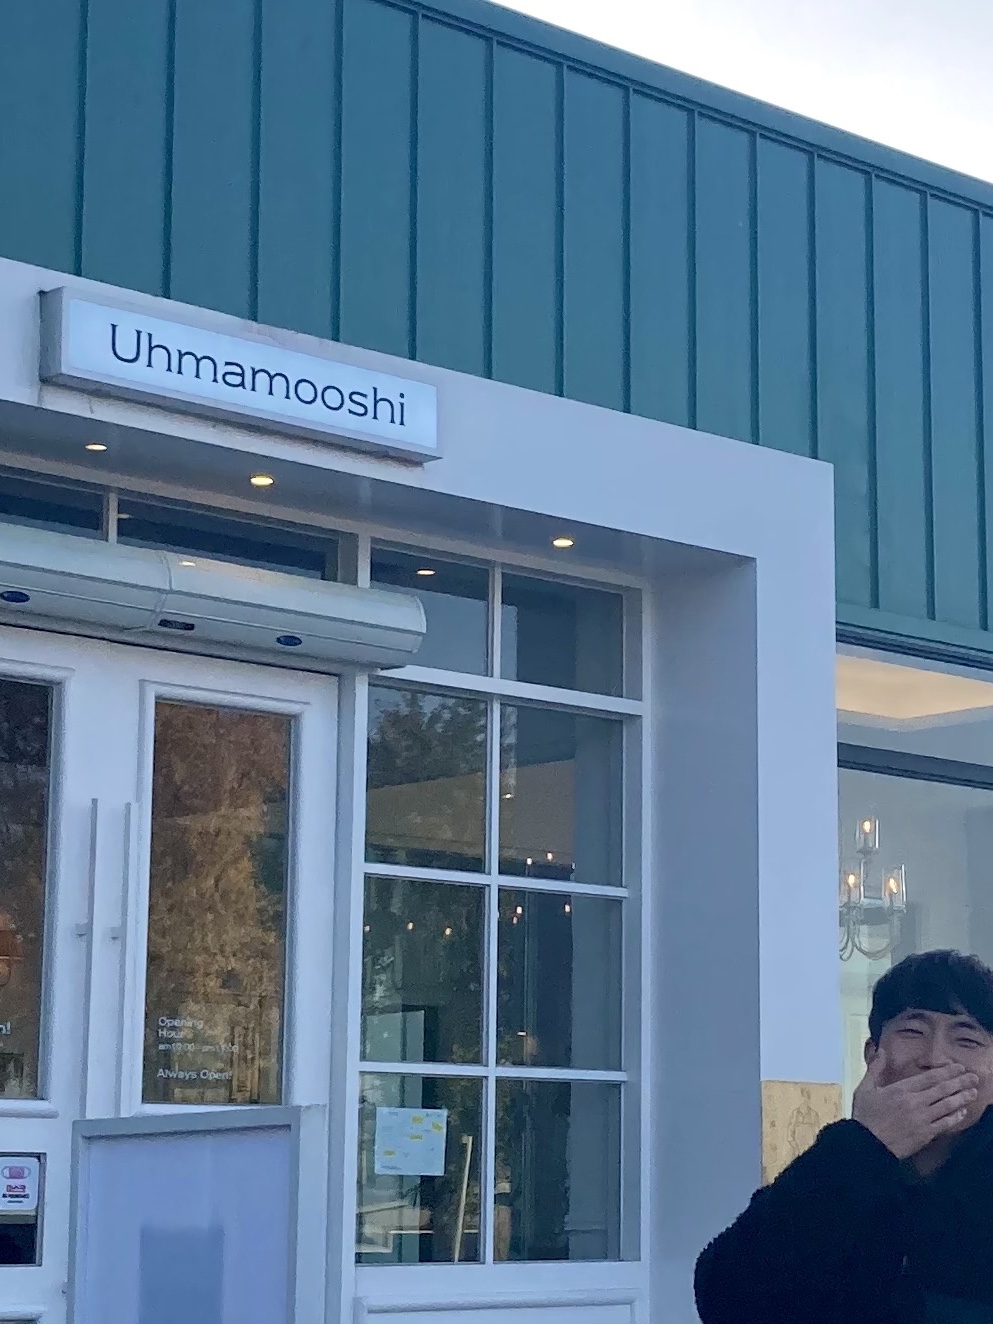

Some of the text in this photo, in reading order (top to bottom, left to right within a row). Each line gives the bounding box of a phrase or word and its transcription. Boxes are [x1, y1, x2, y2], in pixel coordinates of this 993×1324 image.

[110, 323, 406, 426] Uhmamooshi
[159, 1016, 204, 1030] Opening
[157, 1068, 198, 1080] Always
